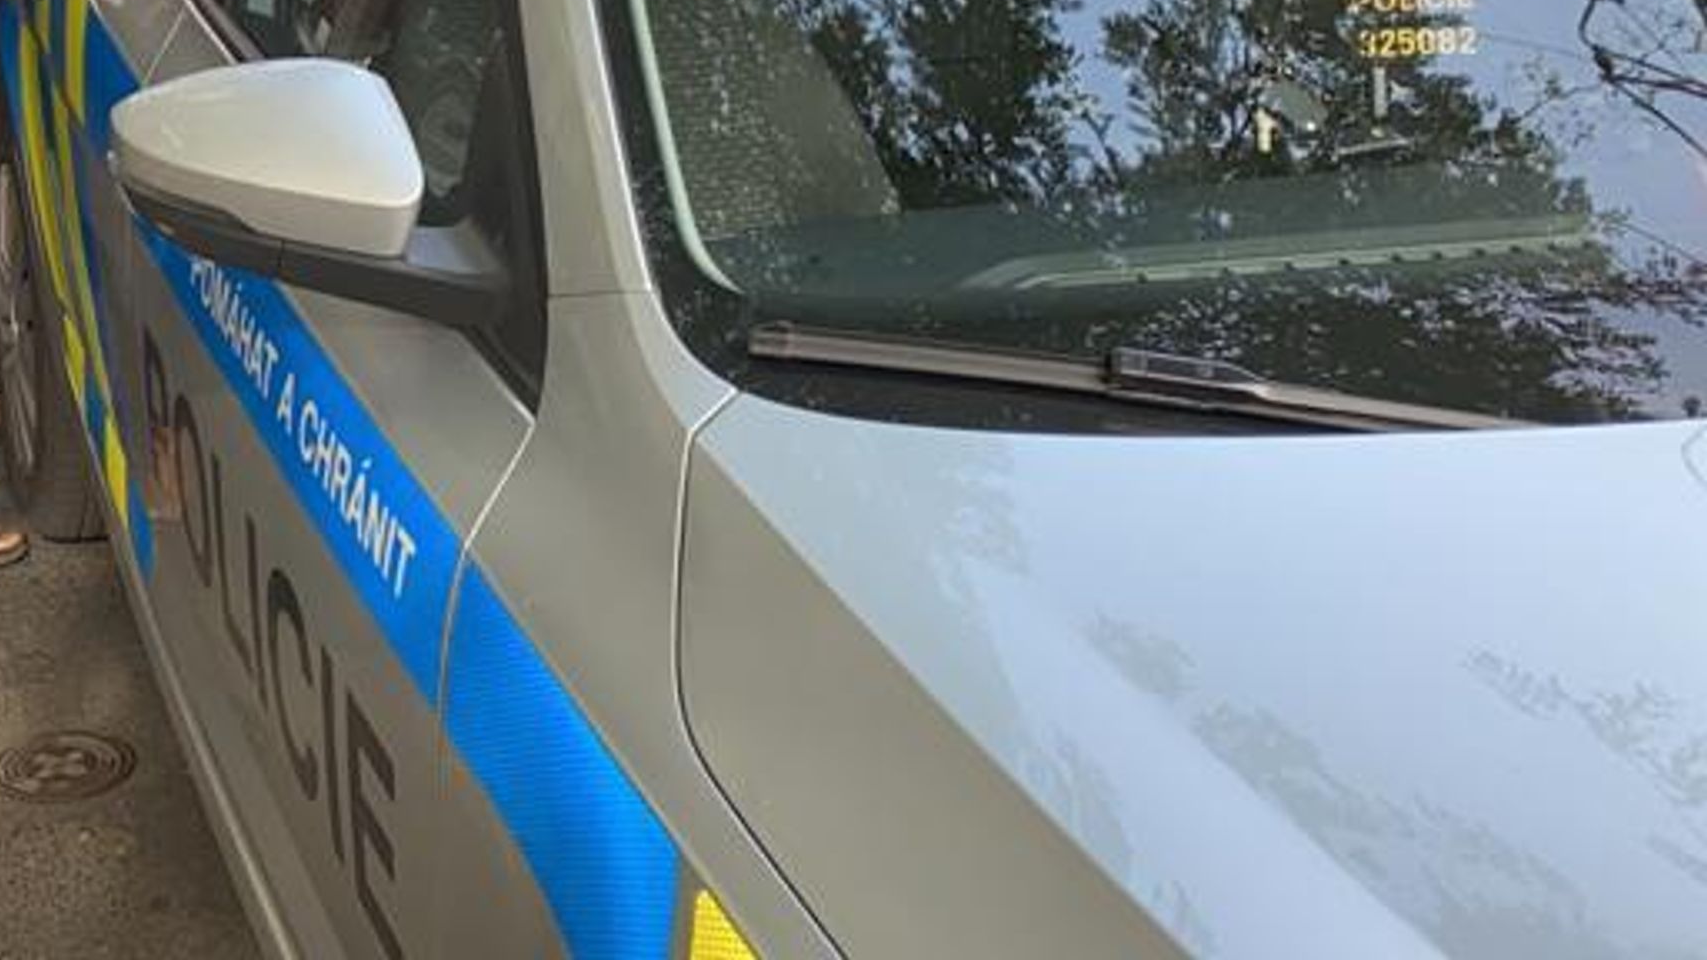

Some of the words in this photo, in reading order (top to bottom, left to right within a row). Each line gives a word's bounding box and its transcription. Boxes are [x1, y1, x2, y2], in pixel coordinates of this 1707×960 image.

[144, 321, 404, 960] POLICIE
[190, 255, 279, 398] POMÁHAT
[276, 372, 294, 435] A
[297, 400, 416, 600] CHRÁNIT
